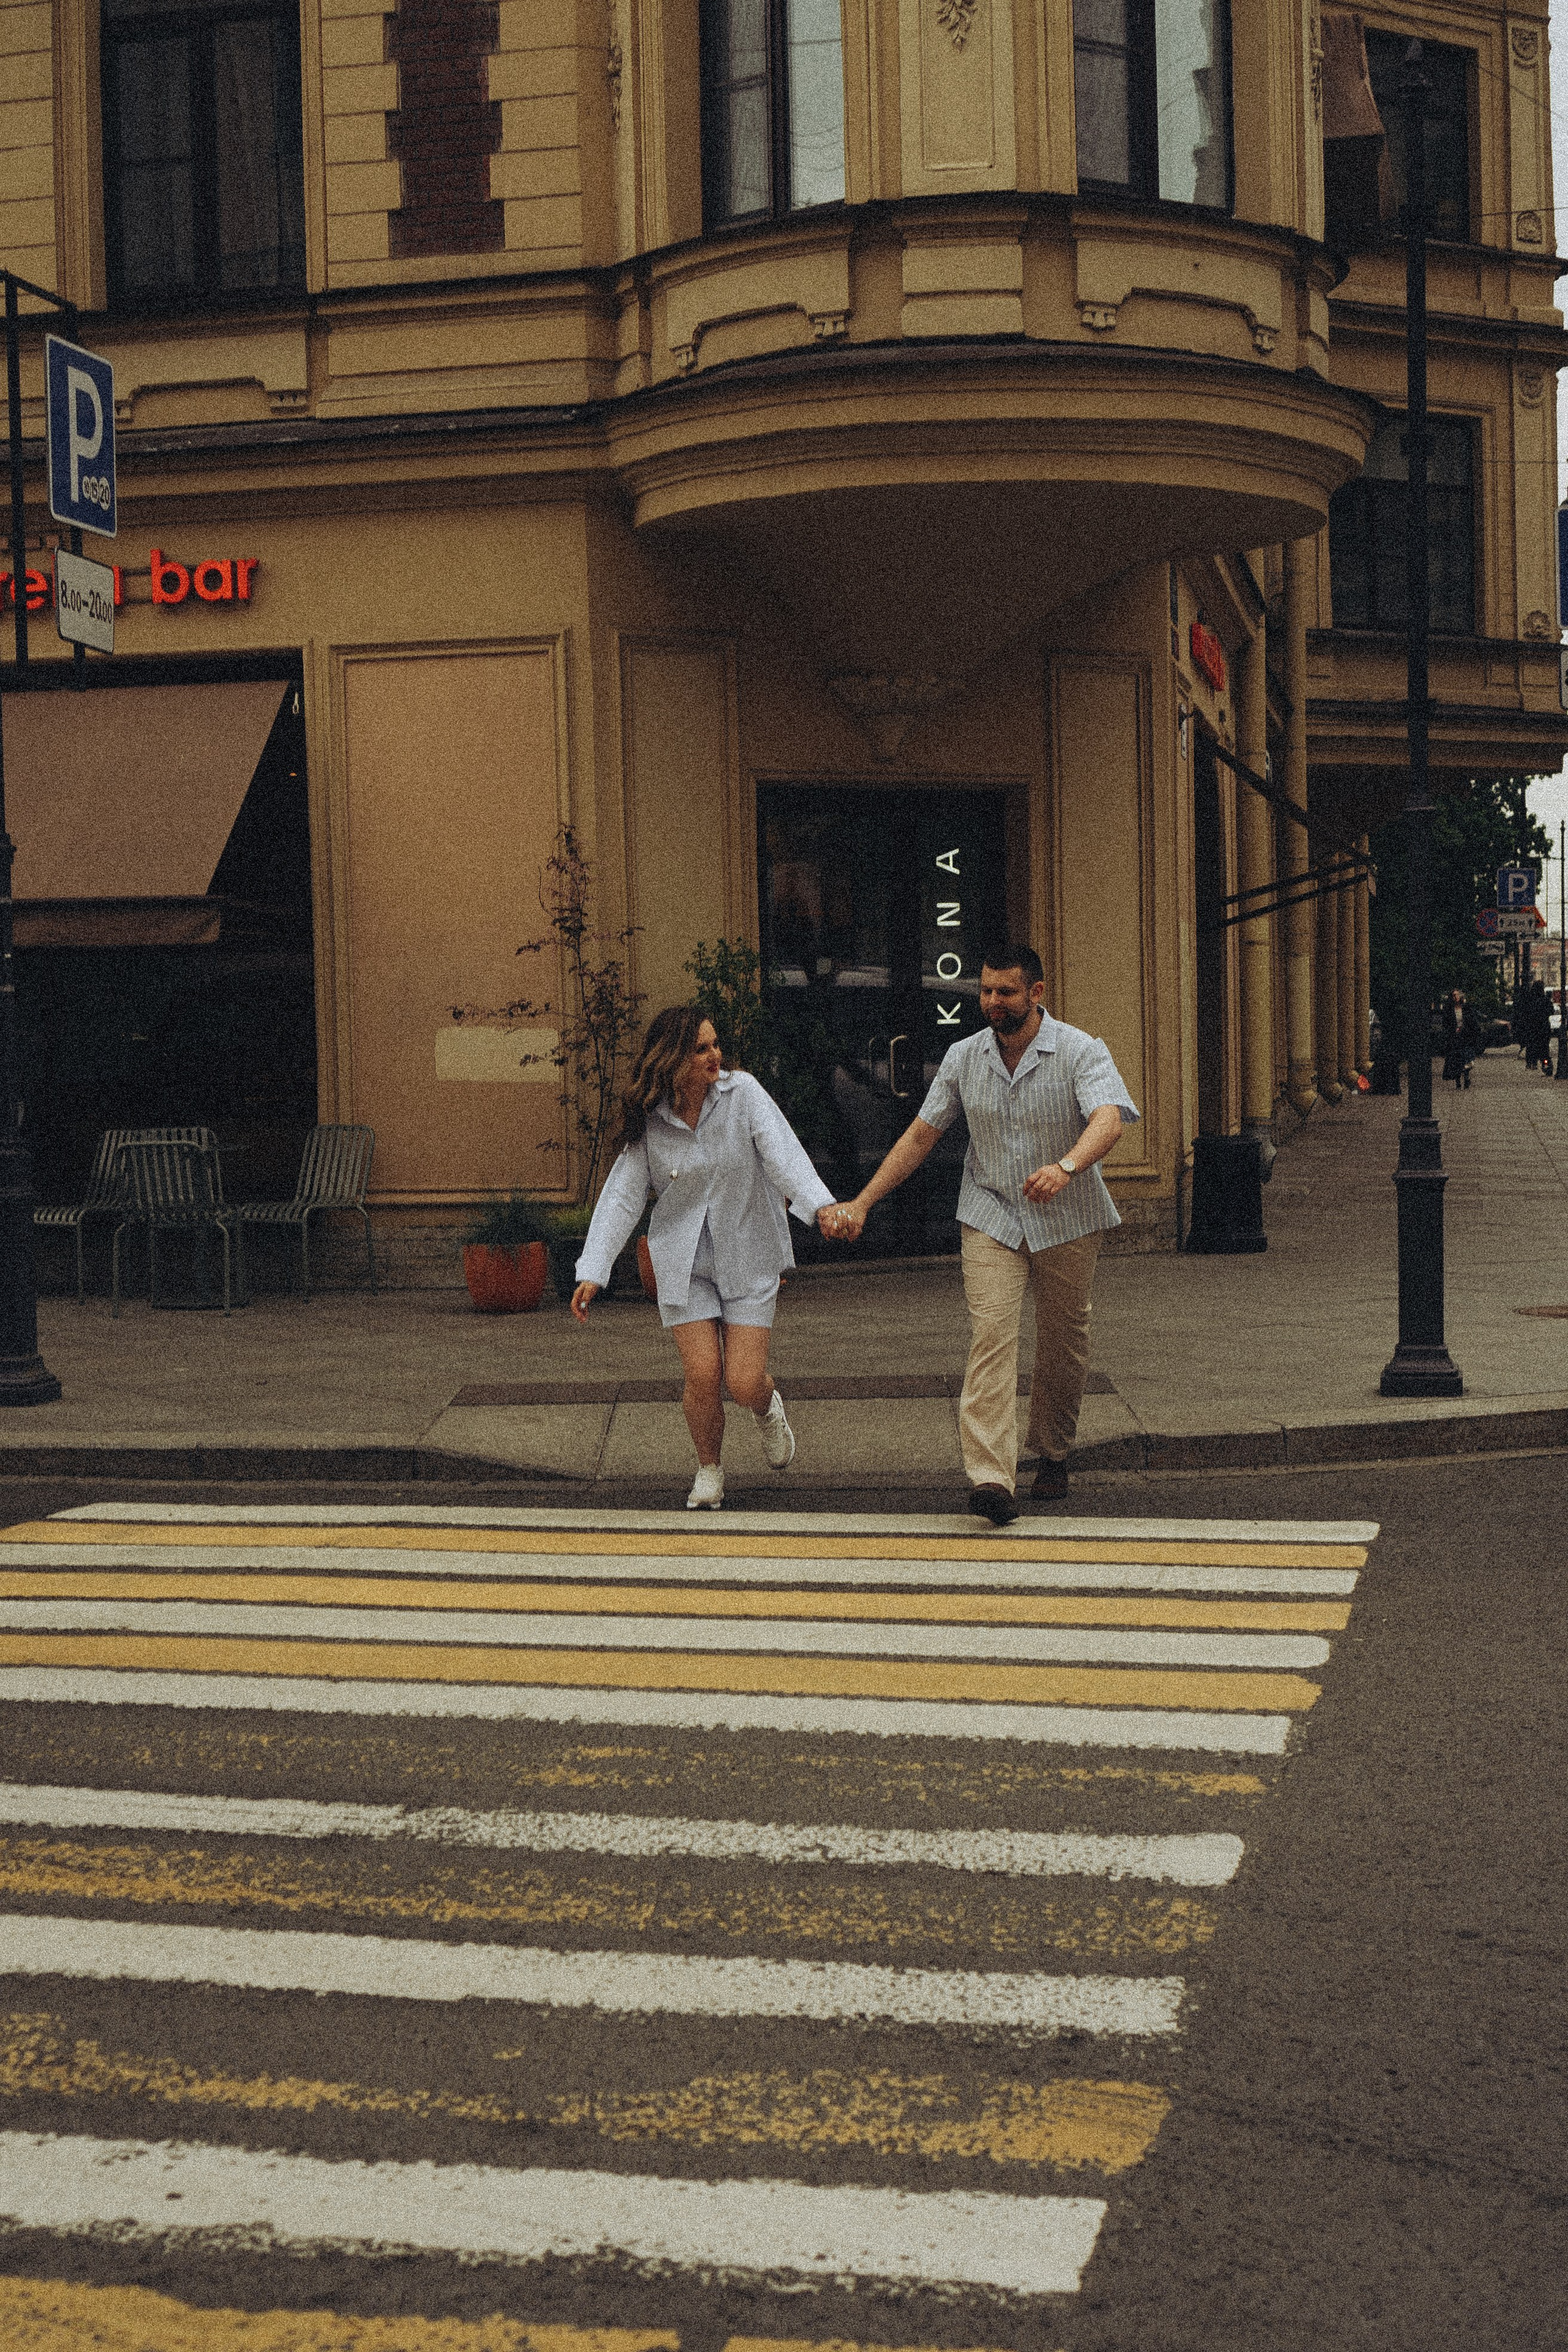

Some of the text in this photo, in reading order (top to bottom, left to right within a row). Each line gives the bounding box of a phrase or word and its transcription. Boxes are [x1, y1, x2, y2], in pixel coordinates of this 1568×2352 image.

[67, 366, 104, 503] P
[99, 483, 110, 505] 20
[150, 548, 257, 604] bar
[1508, 873, 1529, 902] P
[936, 848, 962, 1025] KONA
